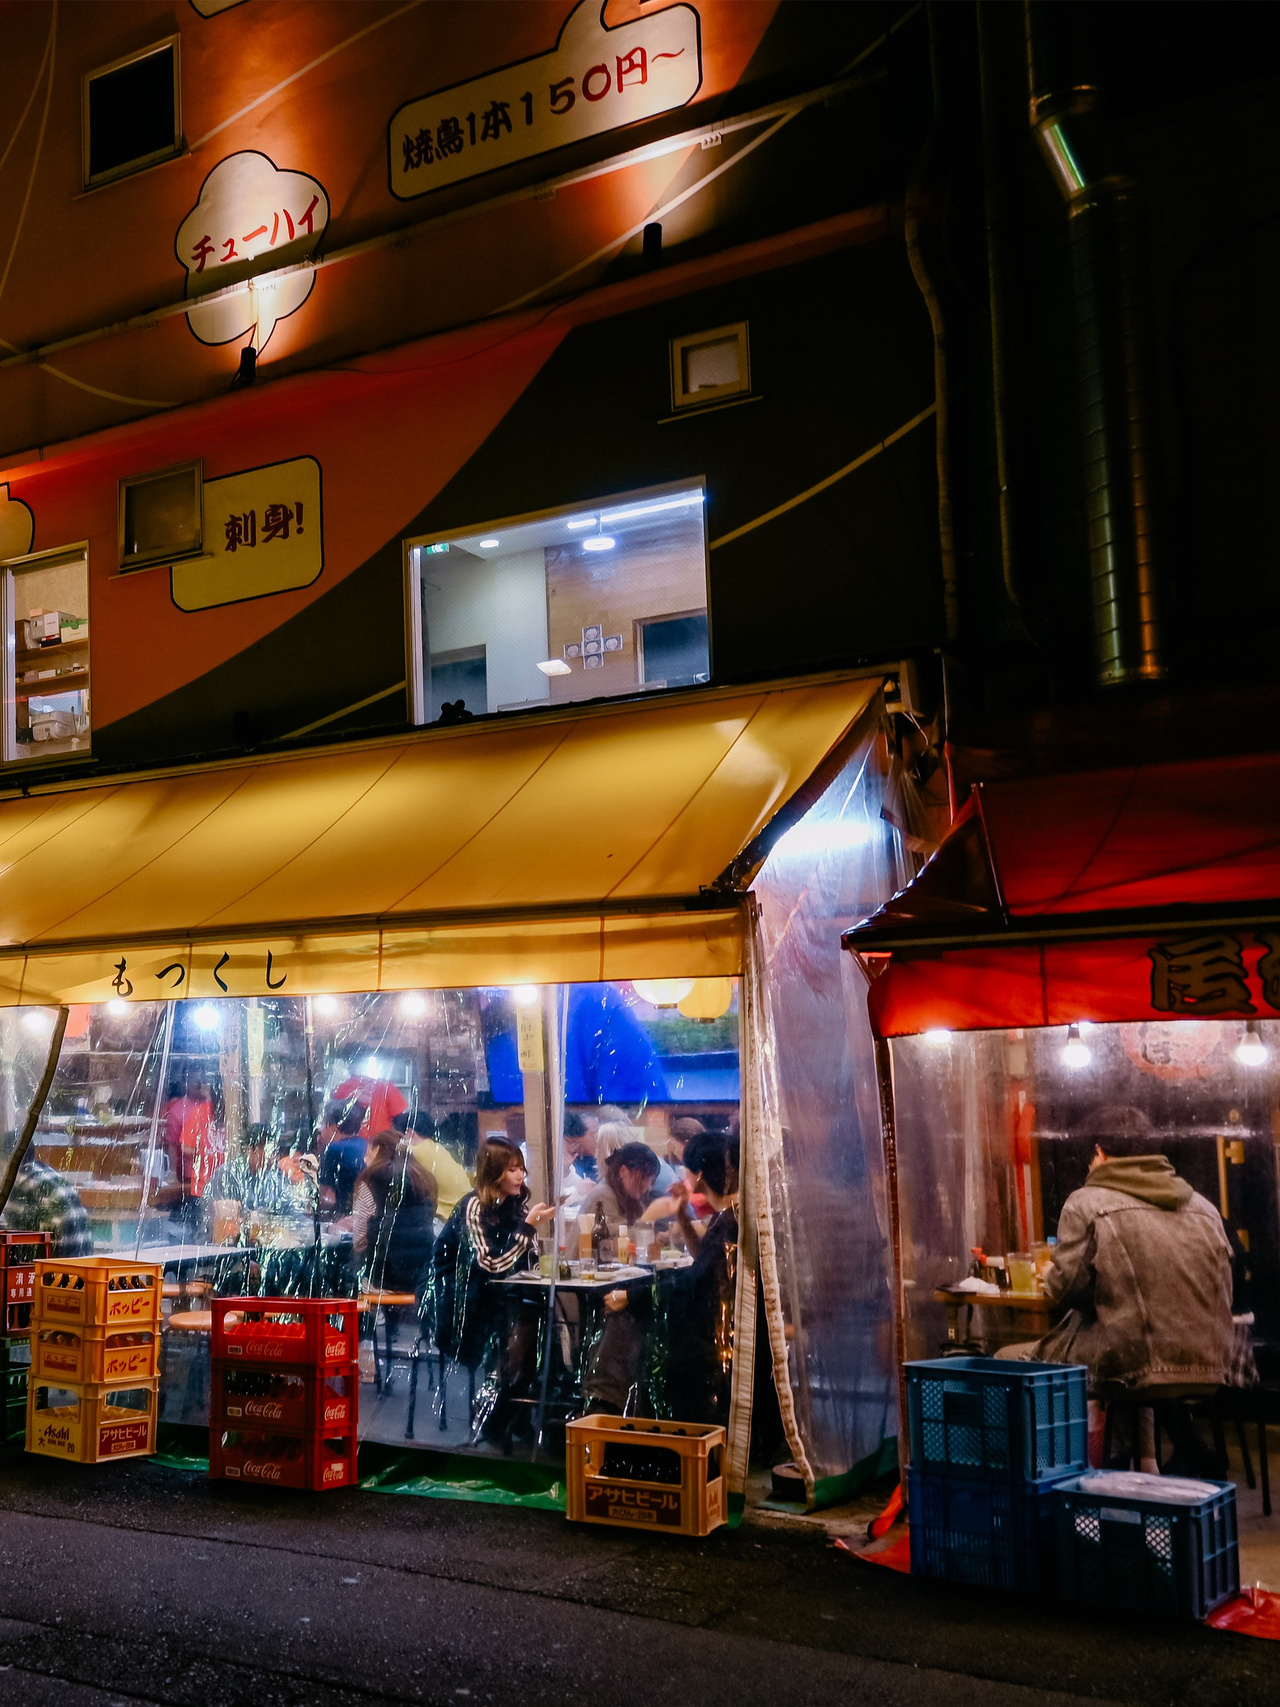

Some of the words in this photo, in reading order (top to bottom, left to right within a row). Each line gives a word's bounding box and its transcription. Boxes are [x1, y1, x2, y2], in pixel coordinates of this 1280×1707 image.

[191, 194, 320, 274] チューハイ
[111, 948, 288, 998] もつくし
[1147, 932, 1280, 1016] 居
[109, 1297, 151, 1316] ホッピー
[245, 1340, 284, 1357] Coca-Cola
[325, 1341, 347, 1358] Coca-Cola
[106, 1353, 148, 1374] ホッピー
[244, 1400, 284, 1419] Coca-Cola
[324, 1404, 346, 1421] Coca-Cola
[43, 1423, 70, 1441] Asahi
[101, 1425, 147, 1443] アサヒビール
[67, 1442, 75, 1454] 20
[243, 1460, 282, 1480] Coca-Cola
[587, 1485, 679, 1510] アサヒビール
